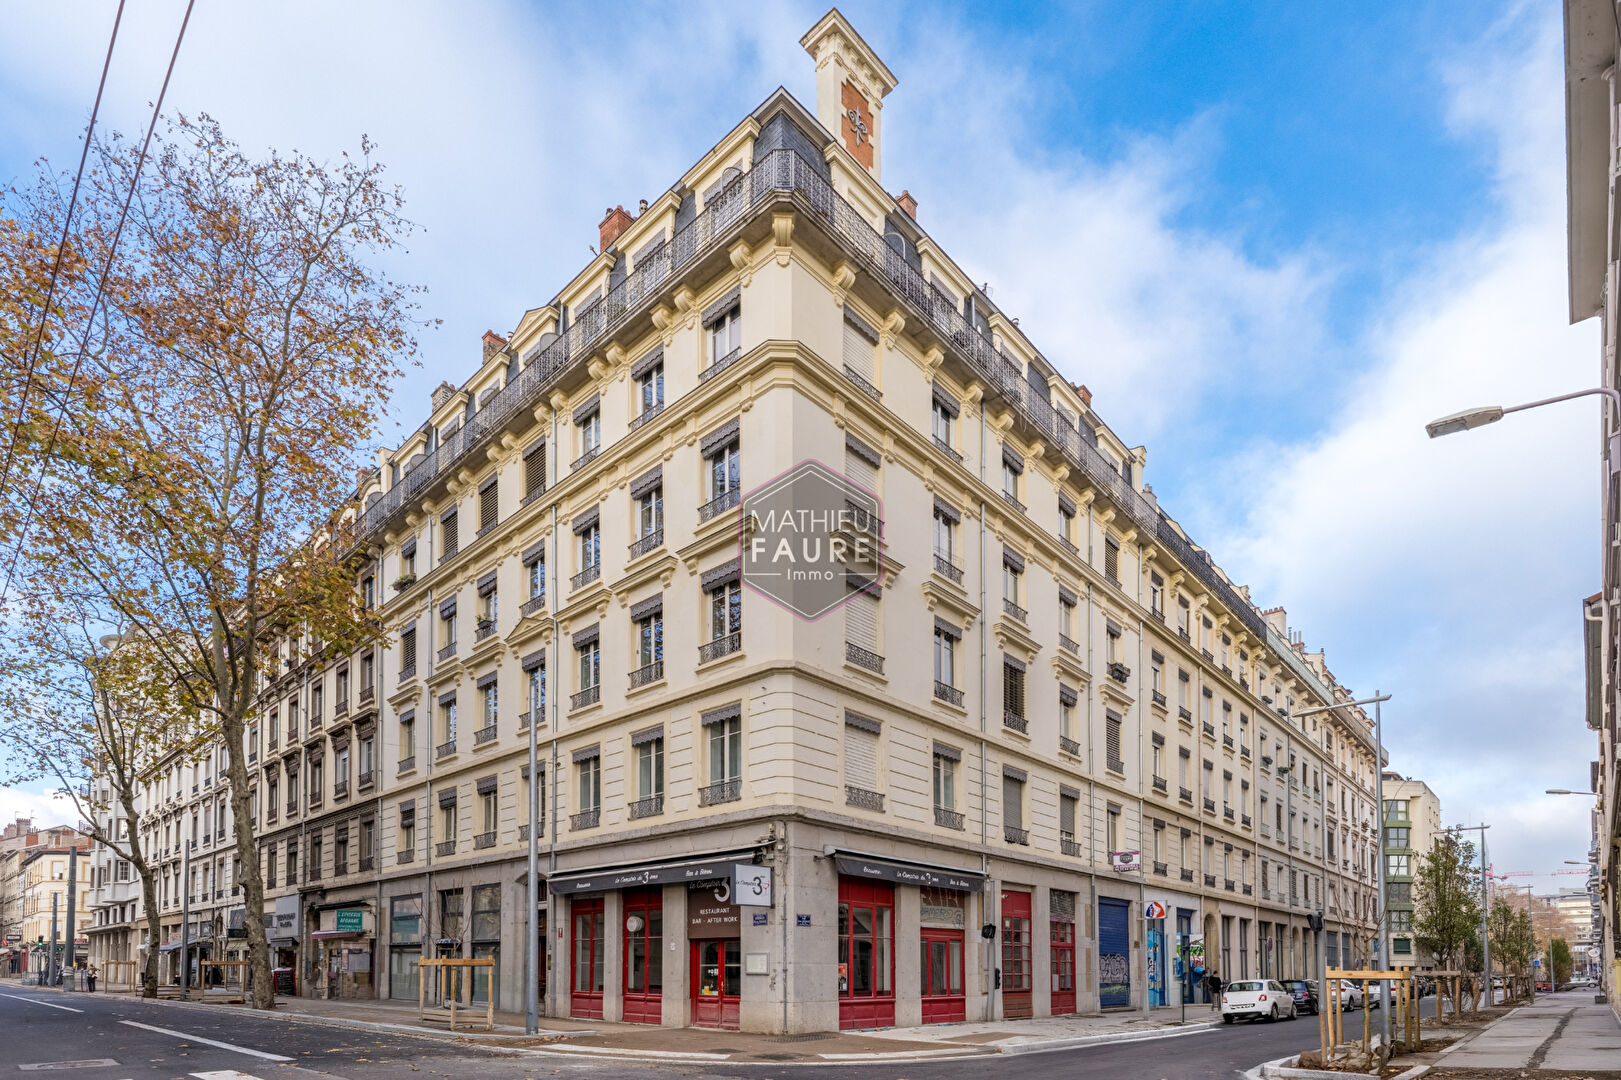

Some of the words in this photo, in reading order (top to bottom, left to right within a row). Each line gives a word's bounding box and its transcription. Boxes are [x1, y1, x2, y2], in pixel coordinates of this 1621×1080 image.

[642, 871, 649, 884] 3
[752, 876, 763, 896] 3
[700, 907, 730, 915] RESTAURANT
